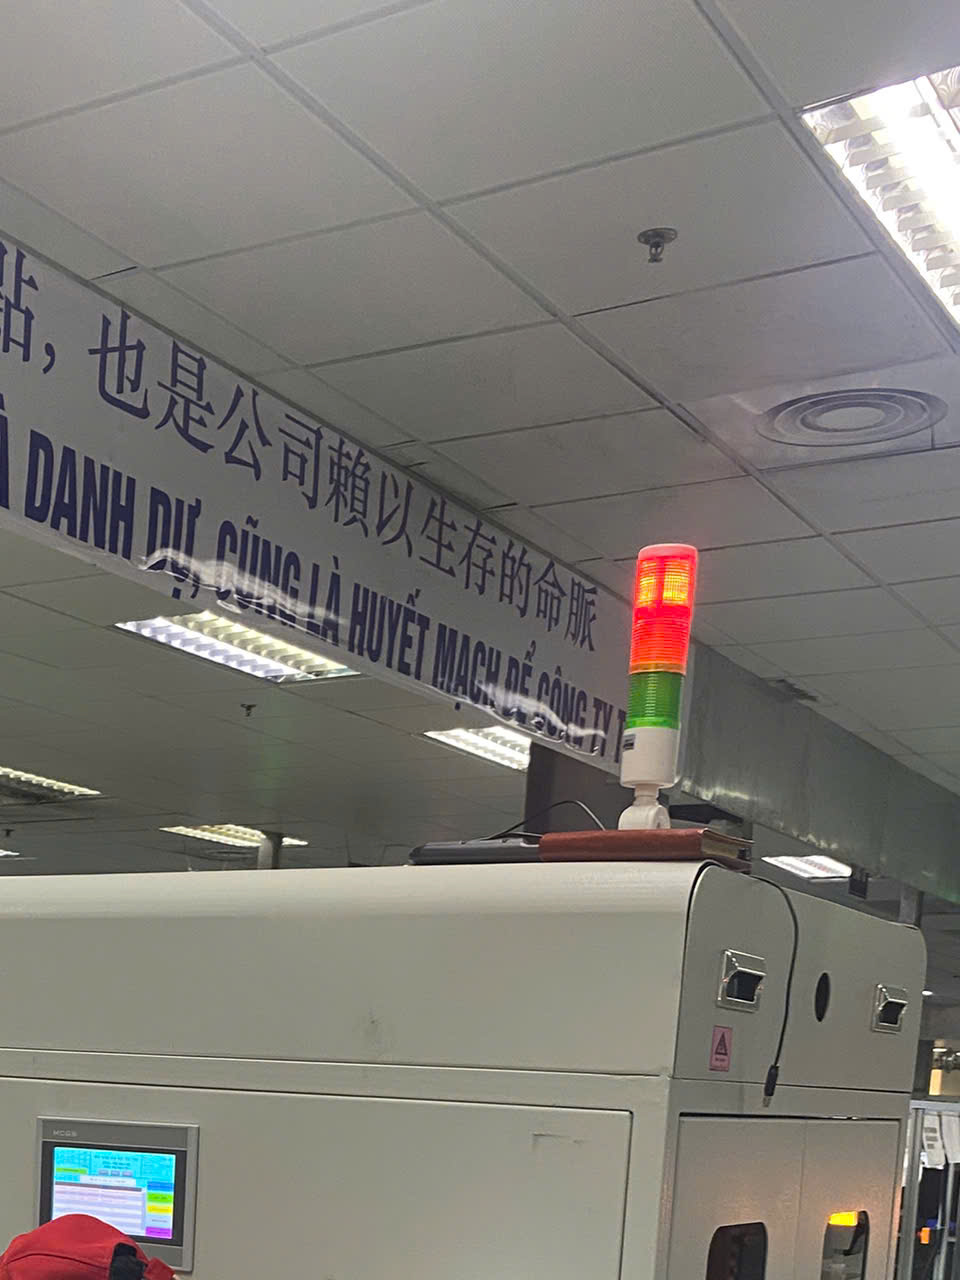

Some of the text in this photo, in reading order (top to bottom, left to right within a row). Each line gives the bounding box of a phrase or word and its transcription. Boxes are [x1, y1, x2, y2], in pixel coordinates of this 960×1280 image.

[24, 430, 136, 560] DANH
[215, 515, 301, 628] CŨNG
[306, 555, 341, 646] LÀ
[348, 583, 431, 681] HUYẾT
[432, 622, 502, 711] MẠCH
[534, 666, 588, 749] CÔNG
[591, 697, 614, 757] TY
